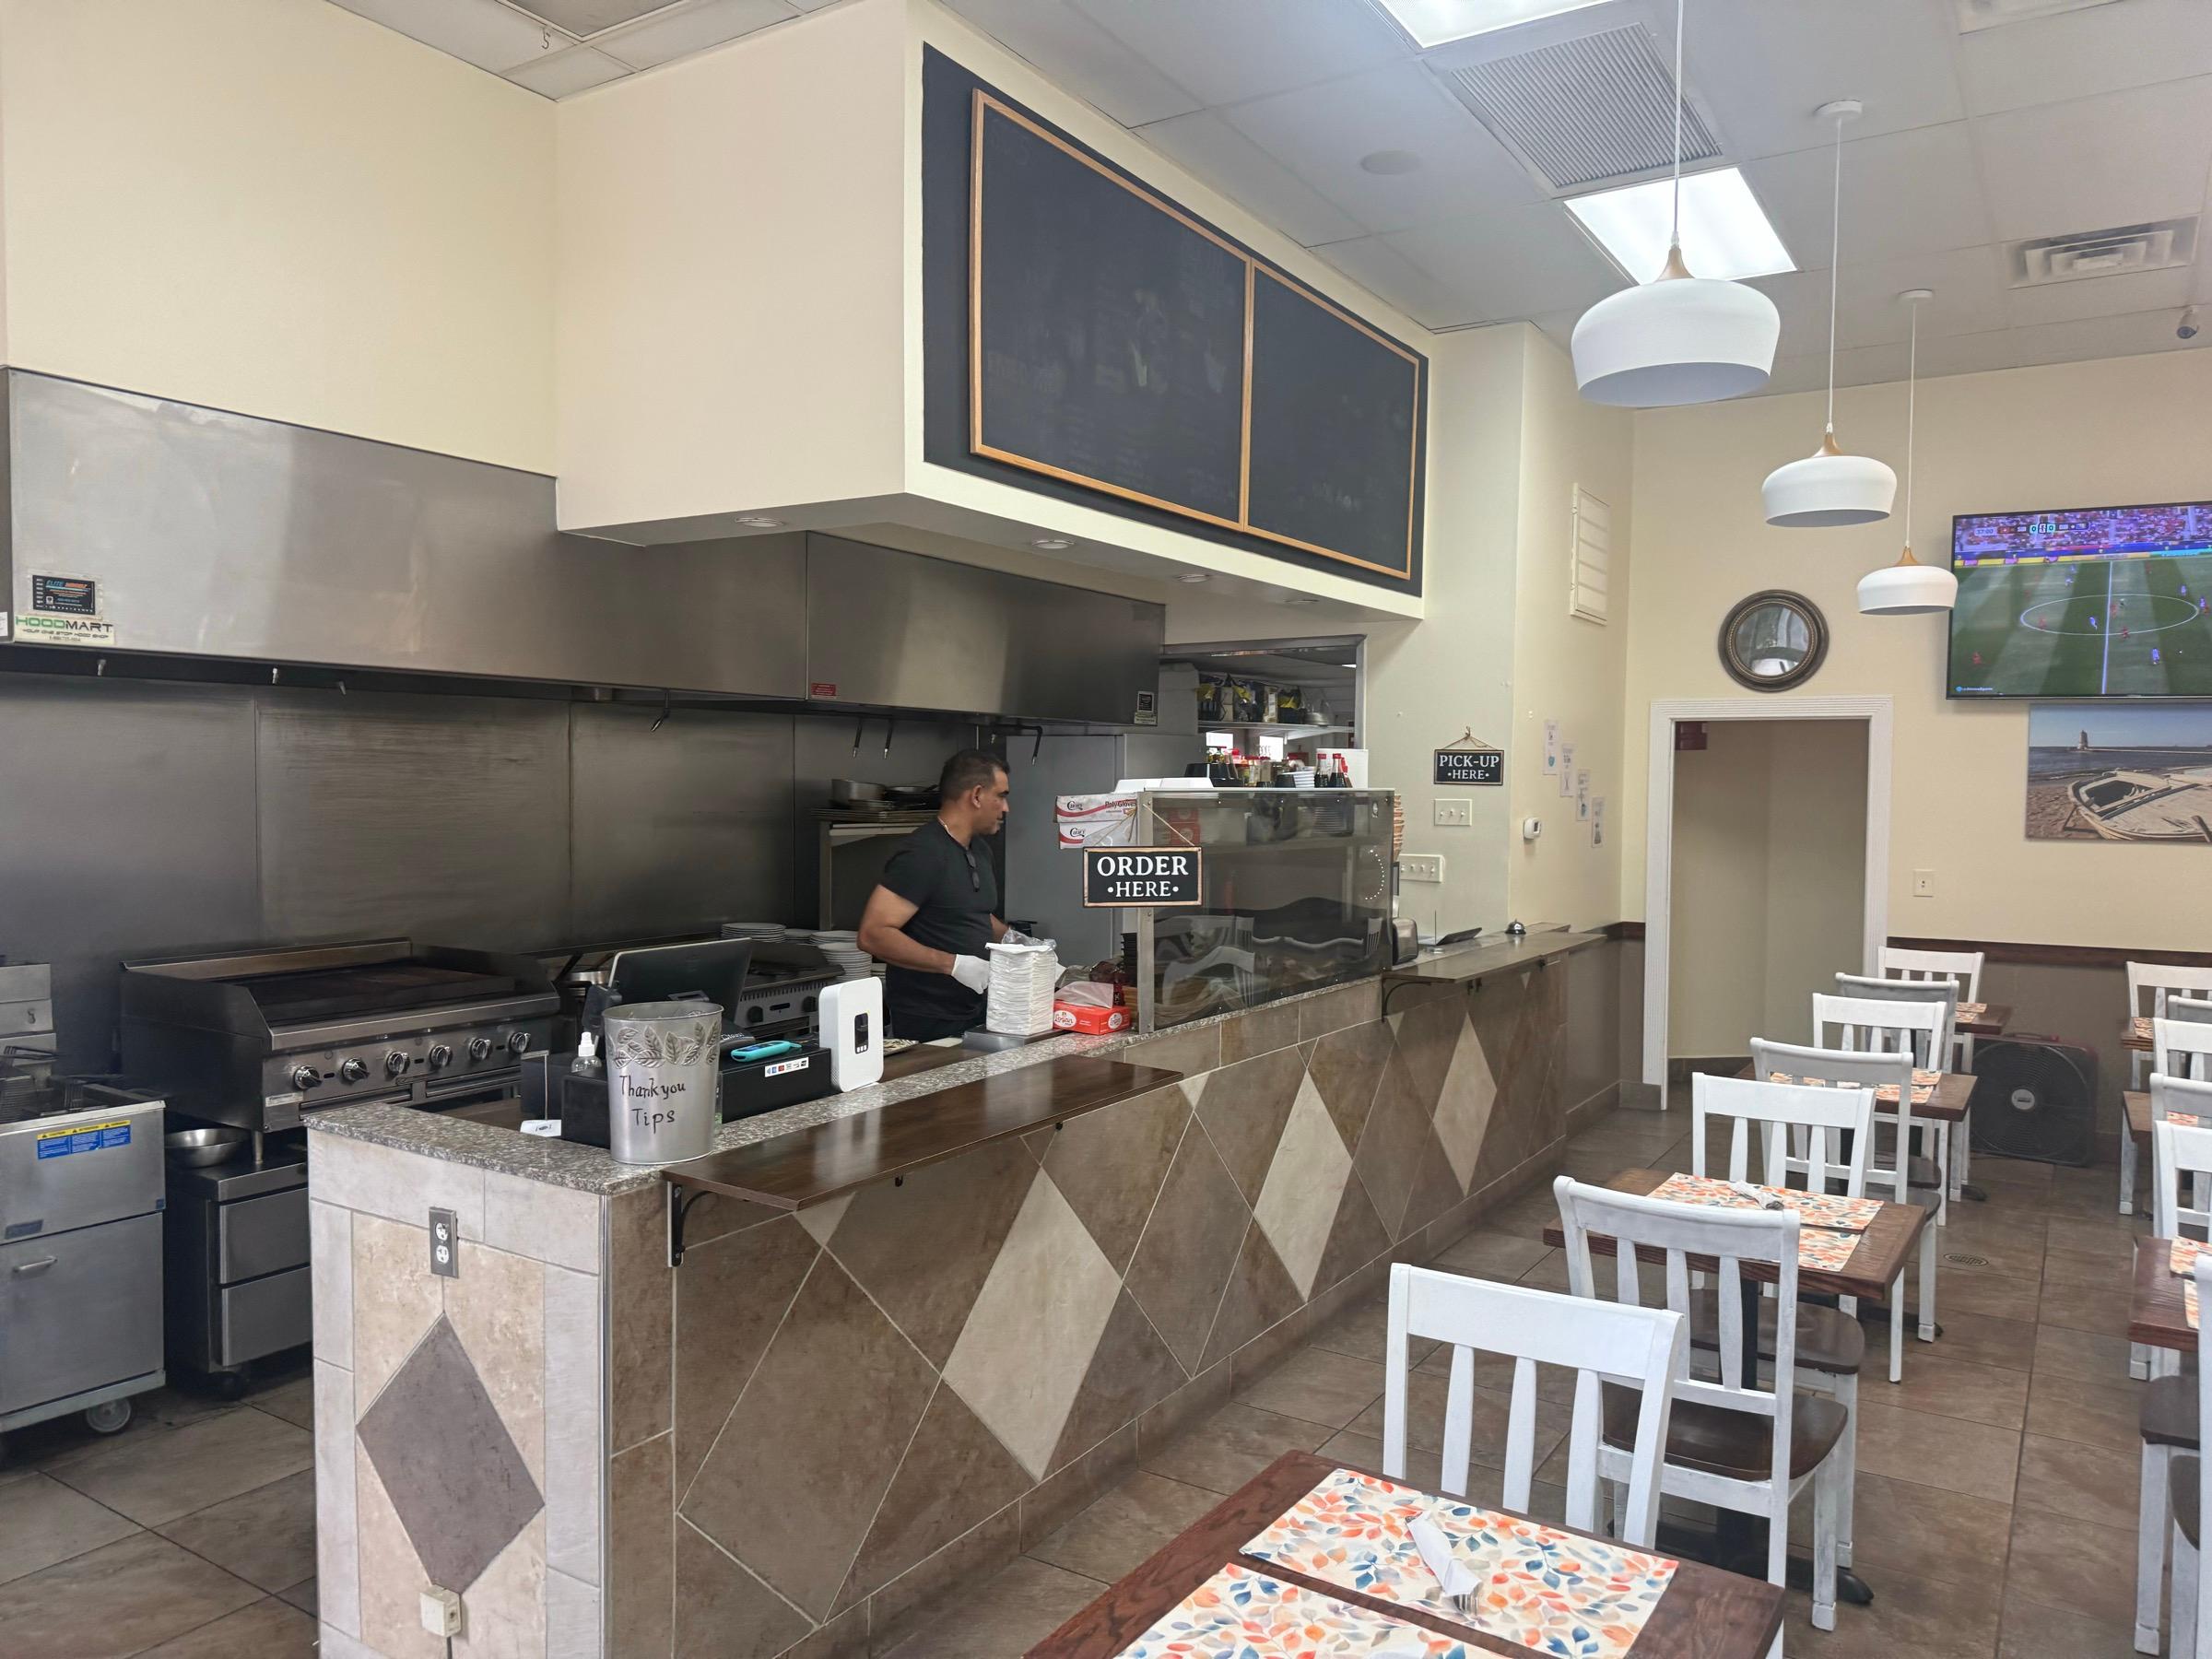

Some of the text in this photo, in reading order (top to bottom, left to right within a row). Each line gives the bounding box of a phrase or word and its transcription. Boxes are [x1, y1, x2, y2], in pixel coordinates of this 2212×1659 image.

[16, 616, 113, 633] HOODMART
[1439, 755, 1500, 768] PICK-UP
[1453, 770, 1485, 780] HERE
[1097, 856, 1189, 877] ORDER
[1115, 881, 1171, 898] HERE
[631, 1108, 676, 1134] Tips
